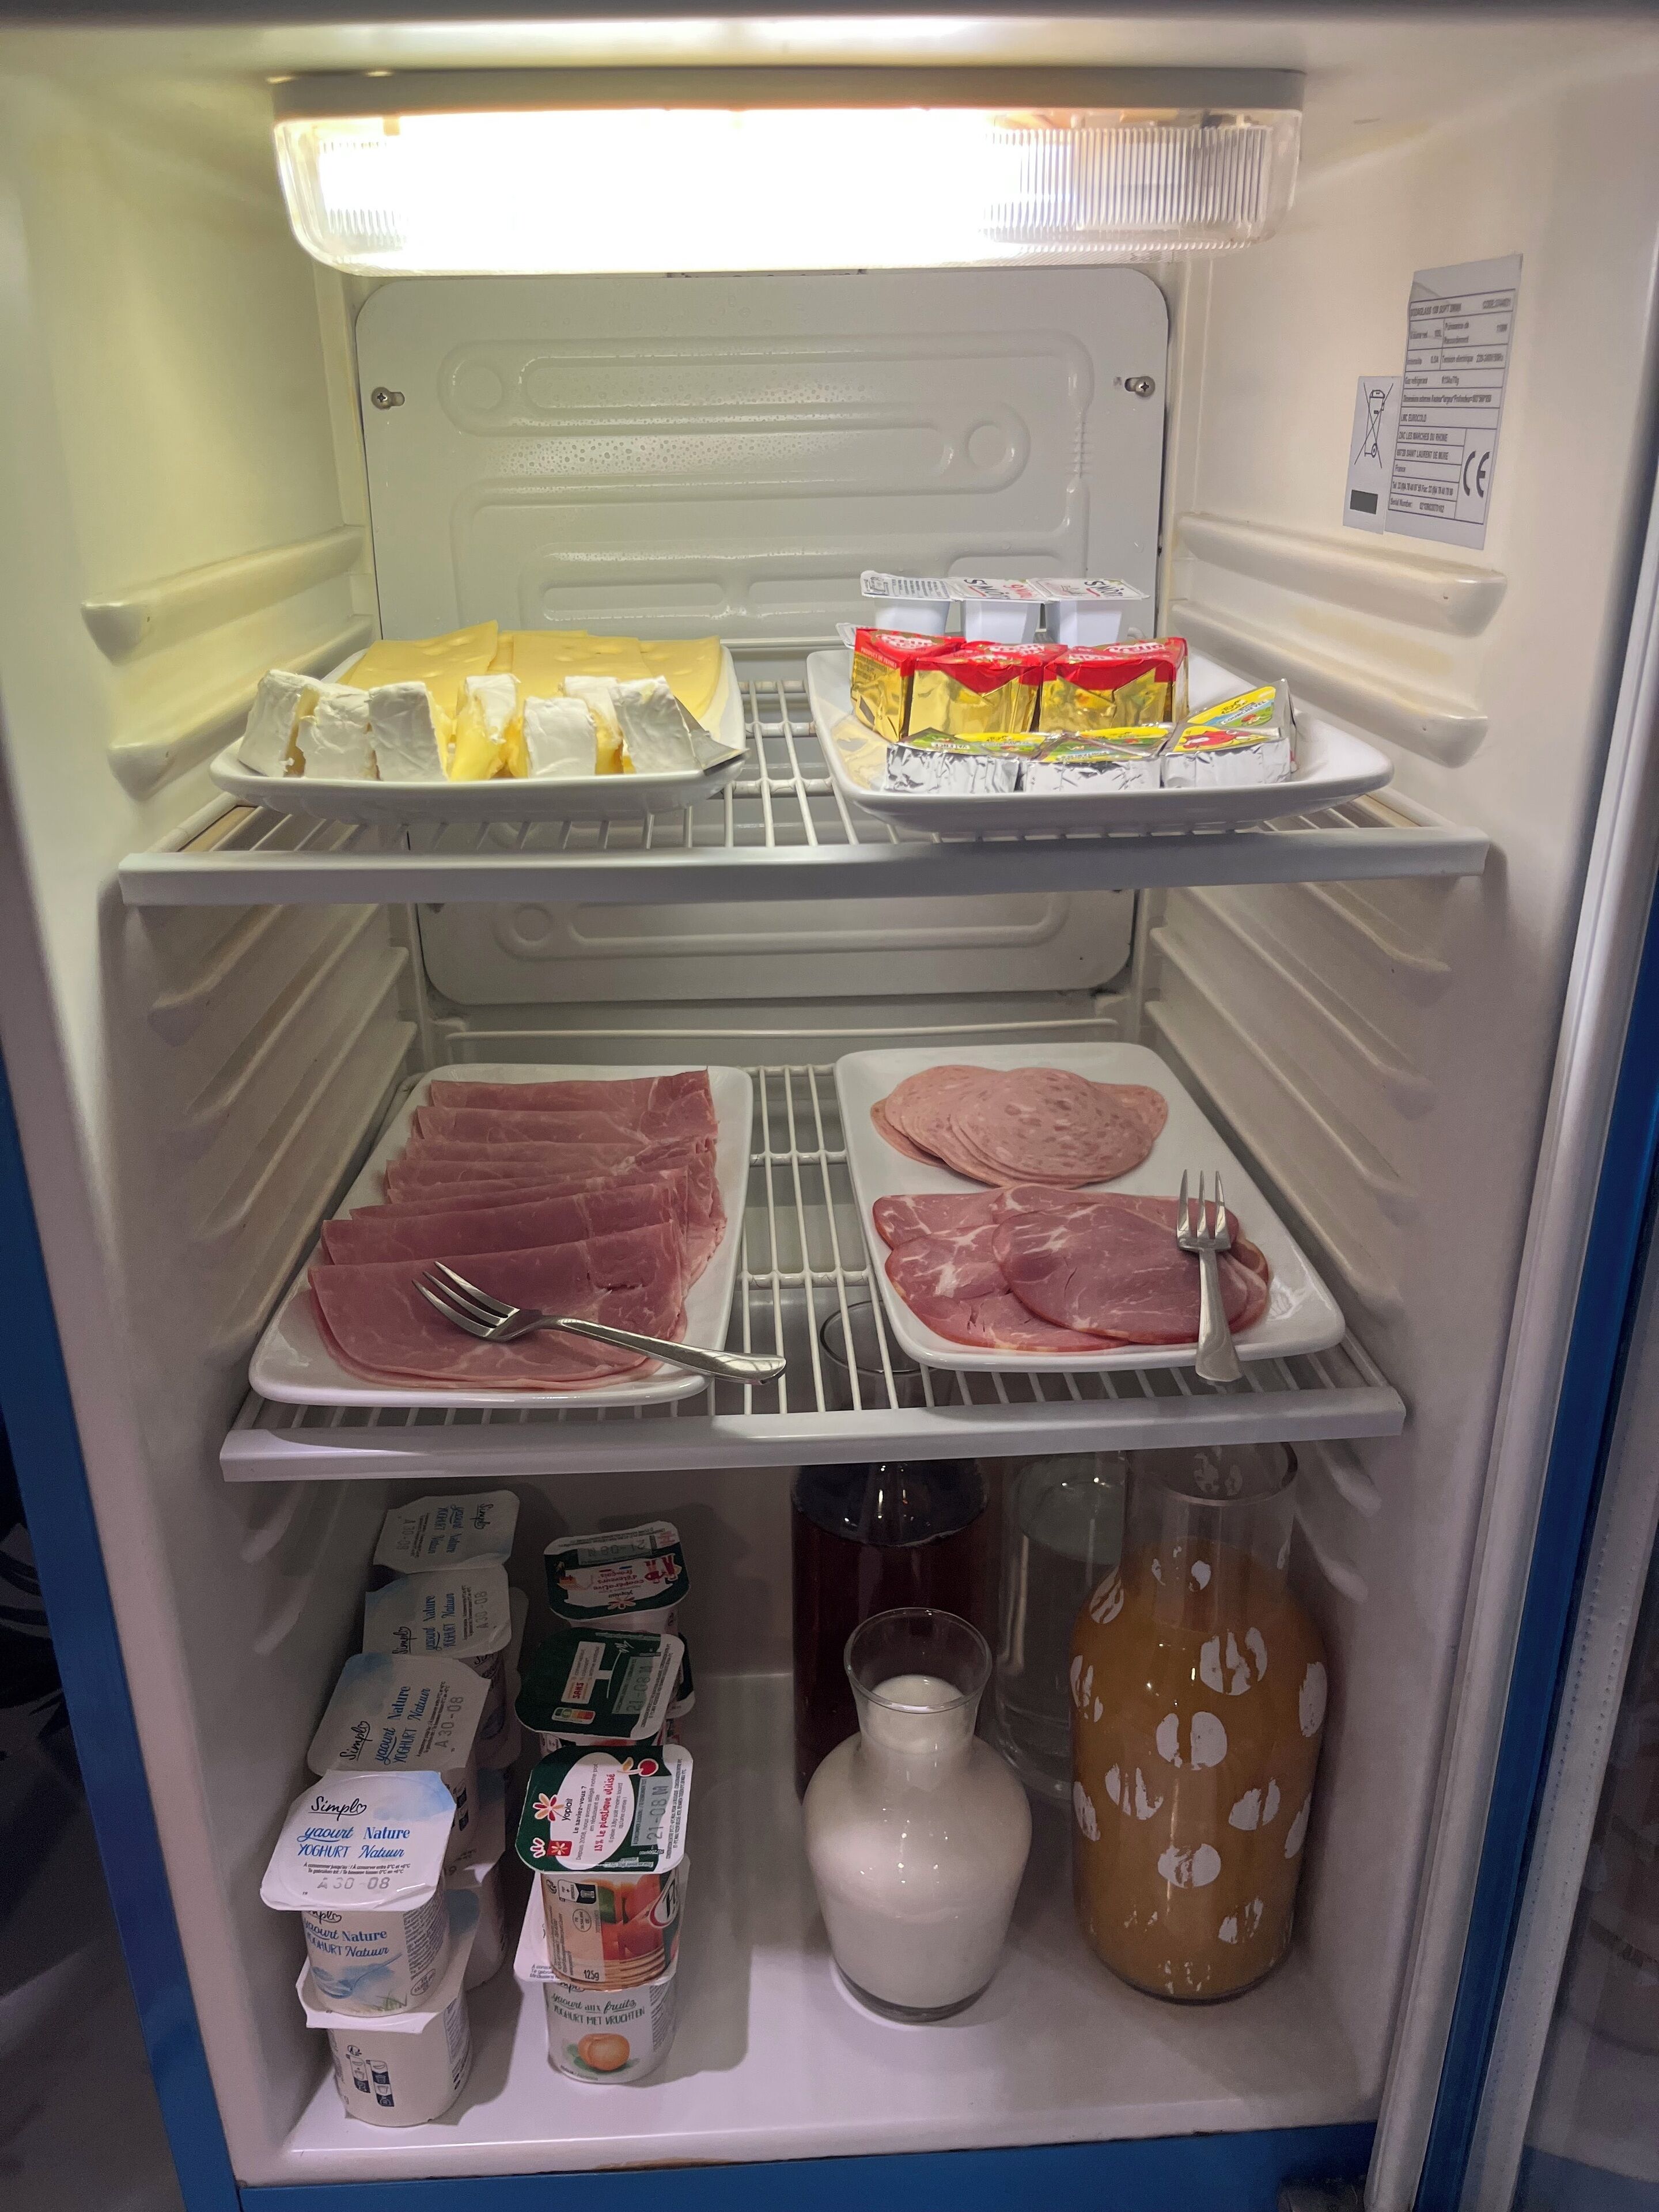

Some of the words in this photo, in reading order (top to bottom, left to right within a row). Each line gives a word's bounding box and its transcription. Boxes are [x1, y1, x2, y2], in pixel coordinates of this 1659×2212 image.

[572, 1682, 584, 1699] SANS
[375, 1728, 397, 1765] yaourt
[387, 1685, 411, 1720] Nature
[393, 1728, 417, 1763] YOGHURT
[407, 1687, 431, 1721] Natuur
[603, 1774, 616, 1795] utilisé
[562, 1798, 573, 1821] Yoplait
[575, 1790, 586, 1827] saviez-vous
[600, 1797, 612, 1828] plastique
[646, 1800, 667, 1840] 21-08
[297, 1826, 354, 1842] yaourt
[363, 1827, 410, 1839] Nature
[298, 1844, 351, 1857] YOGHURT
[358, 1844, 404, 1858] Natuur
[576, 1845, 584, 1861] Depuis
[594, 1838, 603, 1852] 13%
[342, 1930, 387, 1942] Nature
[346, 1945, 389, 1957] Natuur
[584, 1969, 600, 1980] 125g
[585, 2005, 601, 2013] aux
[604, 1999, 636, 2014] fruits
[587, 2017, 602, 2025] MET
[605, 2007, 645, 2025] VRUCHTEN
